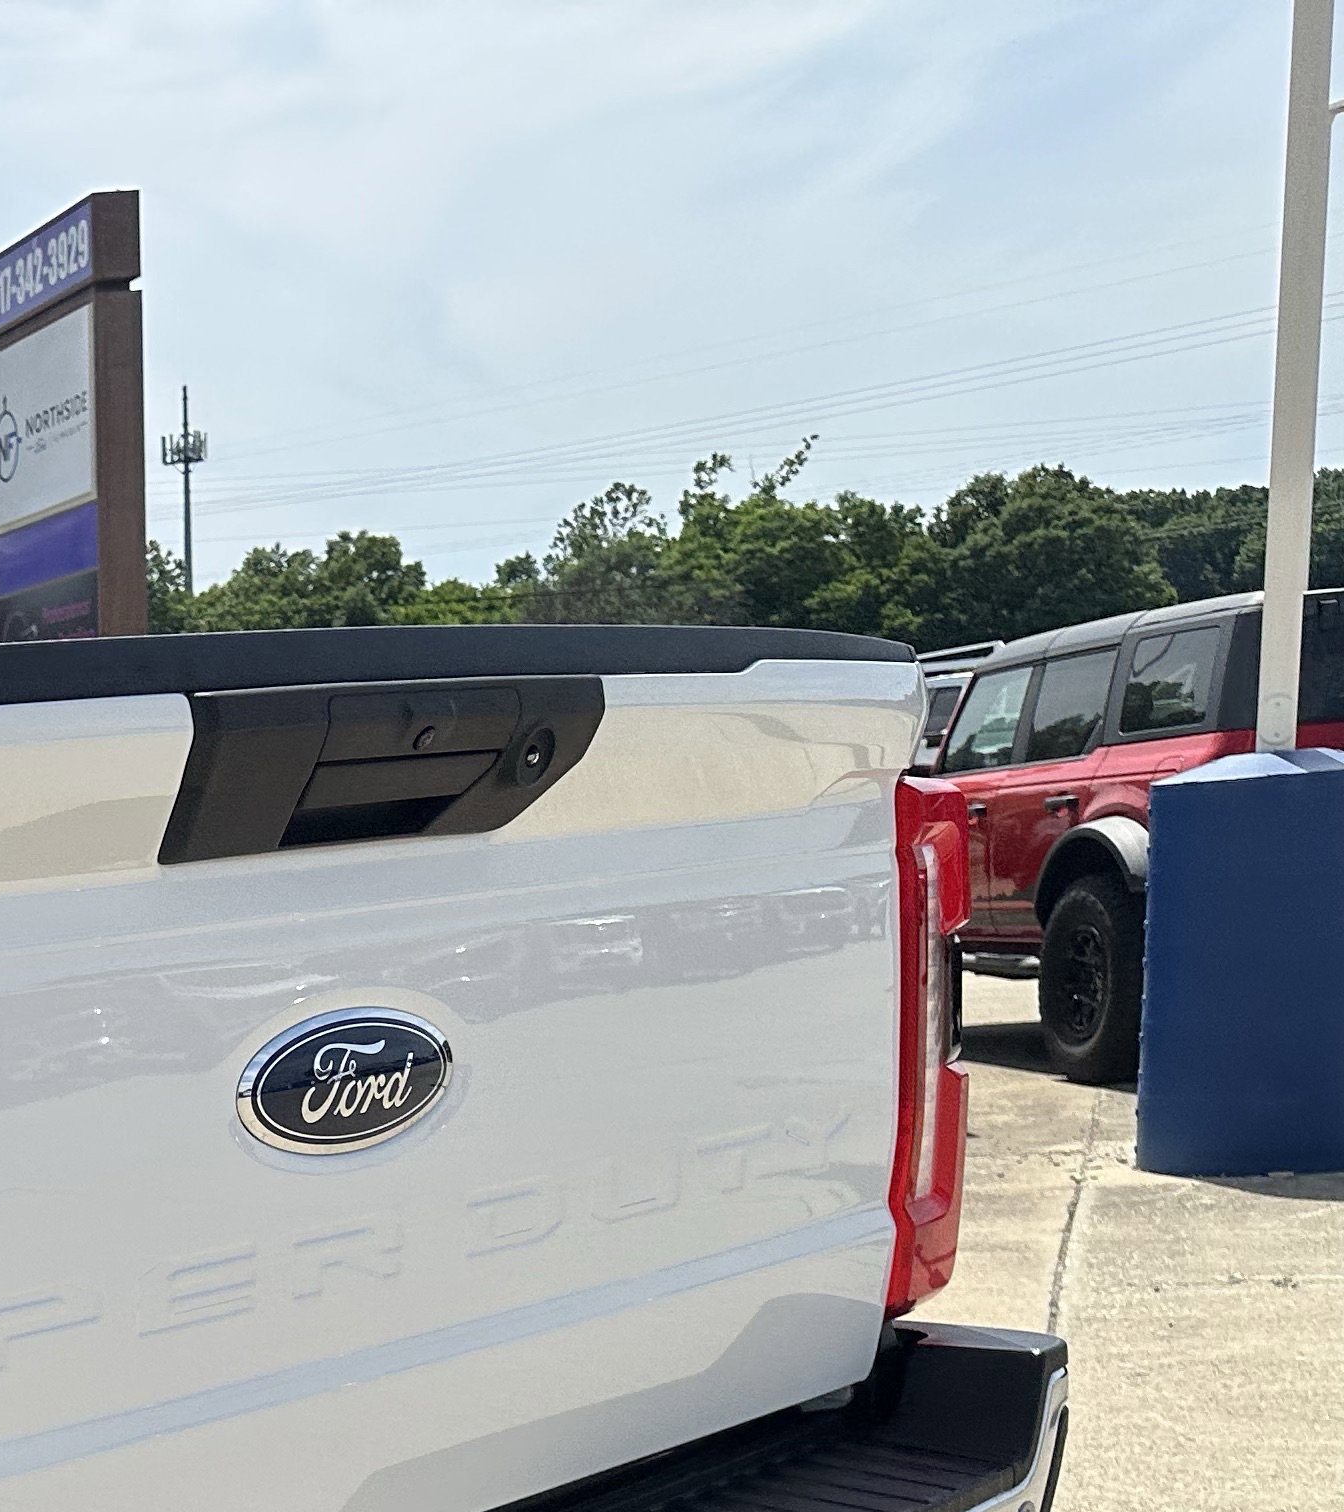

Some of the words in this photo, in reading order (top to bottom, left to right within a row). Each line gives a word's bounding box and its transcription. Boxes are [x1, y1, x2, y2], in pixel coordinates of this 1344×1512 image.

[25, 390, 88, 438] NORTHSIDE
[300, 1039, 414, 1124] Ford
[464, 1108, 852, 1260] DUTY
